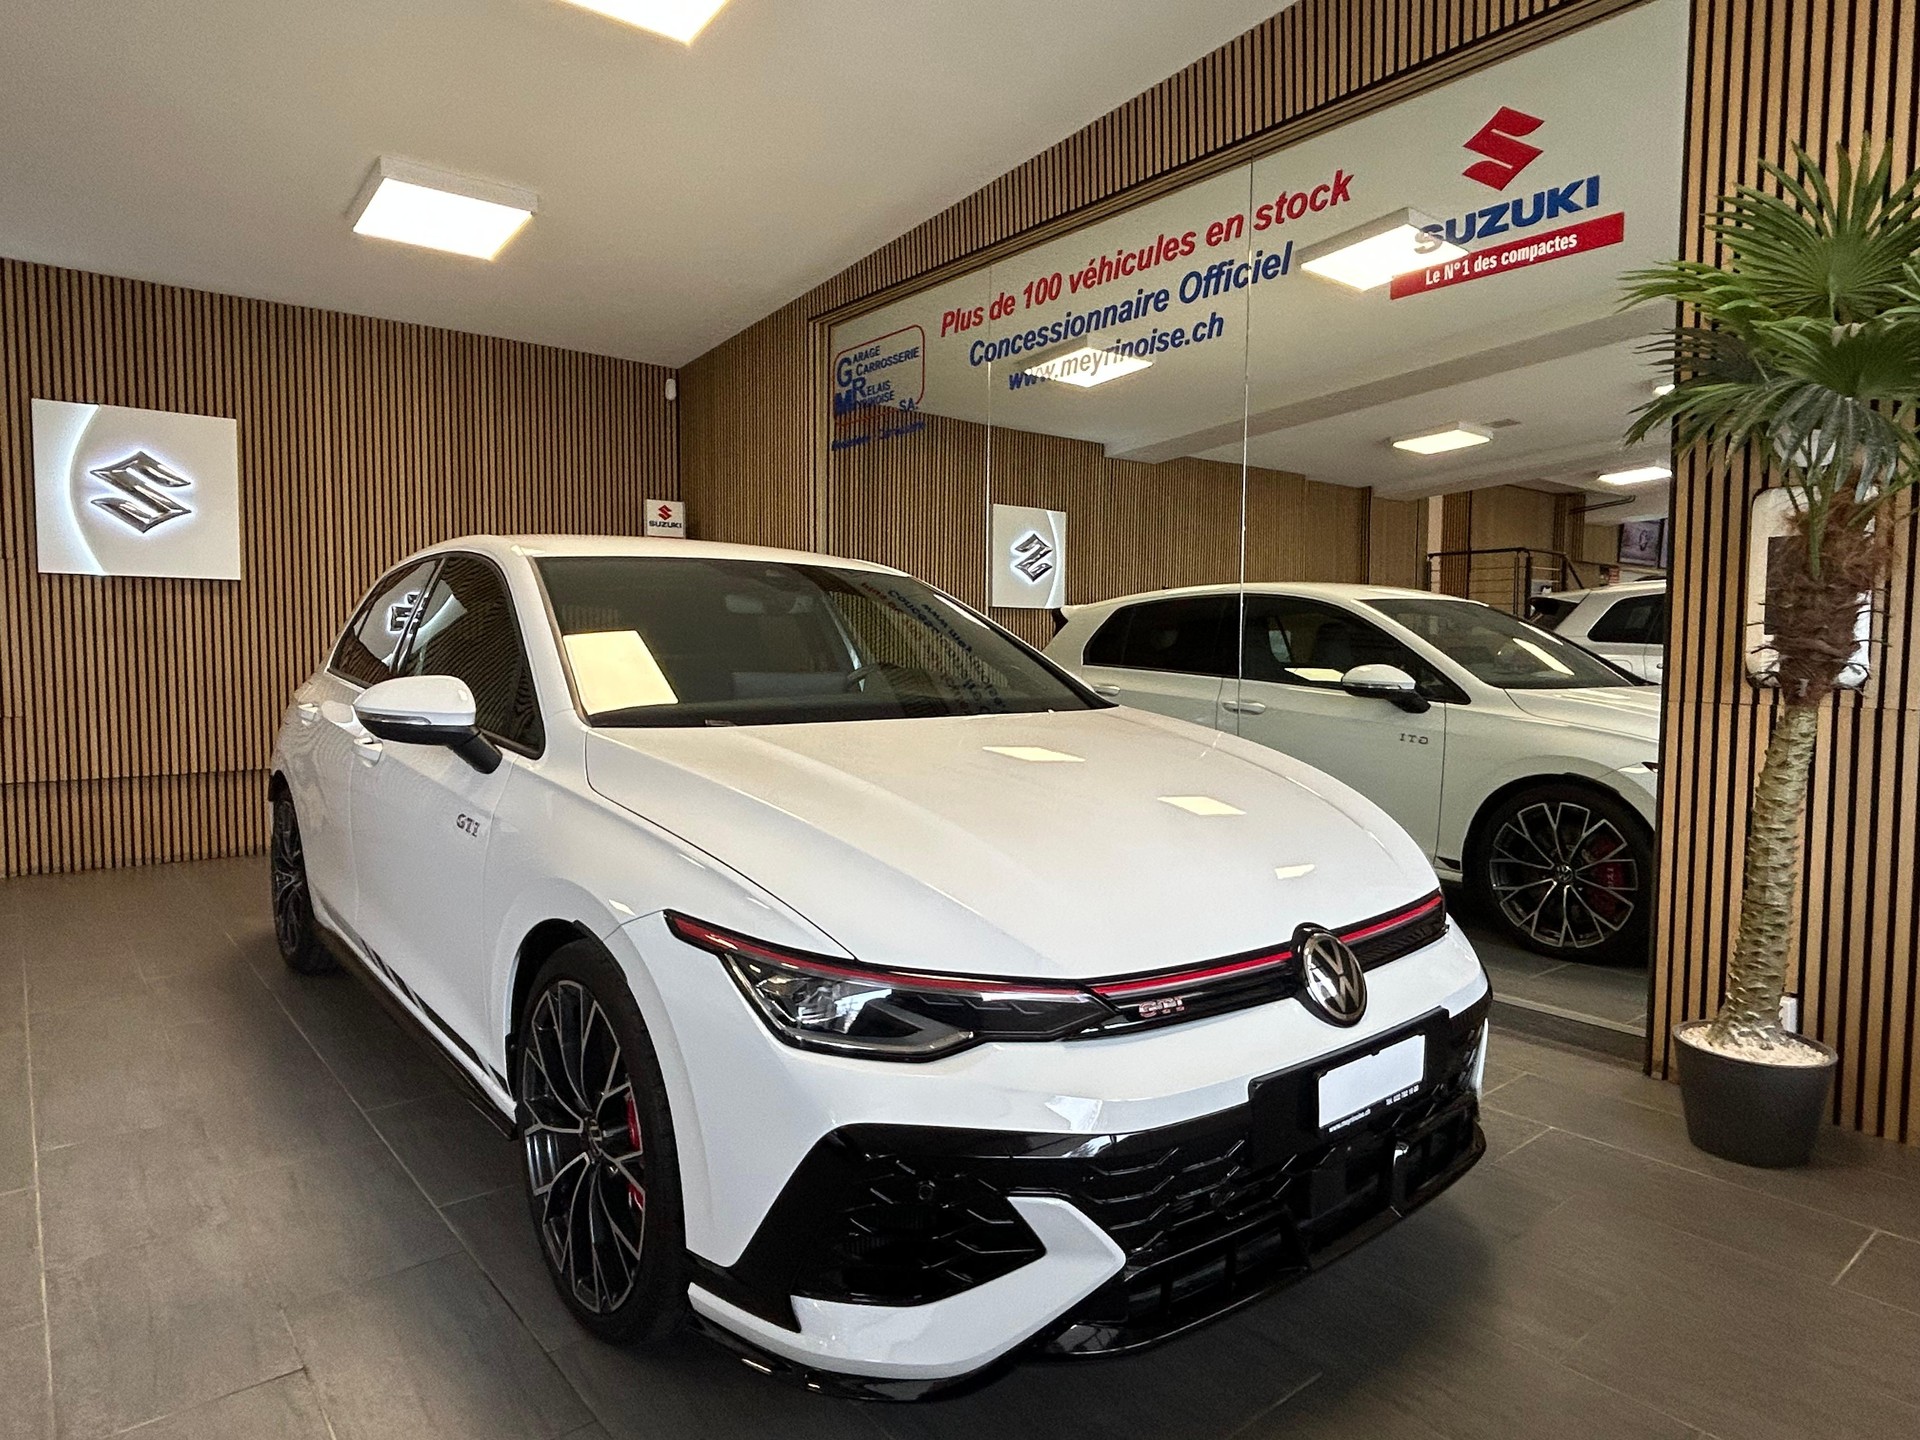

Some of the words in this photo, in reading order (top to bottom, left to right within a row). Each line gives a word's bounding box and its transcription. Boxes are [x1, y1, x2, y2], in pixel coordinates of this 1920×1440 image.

[1414, 174, 1600, 254] SUZUKI
[941, 306, 984, 337] Plus
[989, 292, 1016, 321] de
[1023, 272, 1062, 310] 100
[1069, 229, 1197, 294] véhicules
[1205, 213, 1244, 247] en
[1253, 168, 1355, 231] stock
[1425, 268, 1441, 286] Le
[1443, 258, 1471, 281] N°1
[1473, 251, 1498, 273] des
[1501, 232, 1578, 268] compactes
[970, 284, 1170, 367] Concessionnaire
[1178, 240, 1295, 303] Officiel
[856, 346, 920, 377] CARROSSERIE
[1009, 311, 1225, 391] www.meyrinoise.ch
[852, 376, 891, 398] RELAIS
[648, 520, 683, 529] SUZUKI
[456, 813, 480, 838] GTI
[1138, 996, 1185, 1018] GTI
